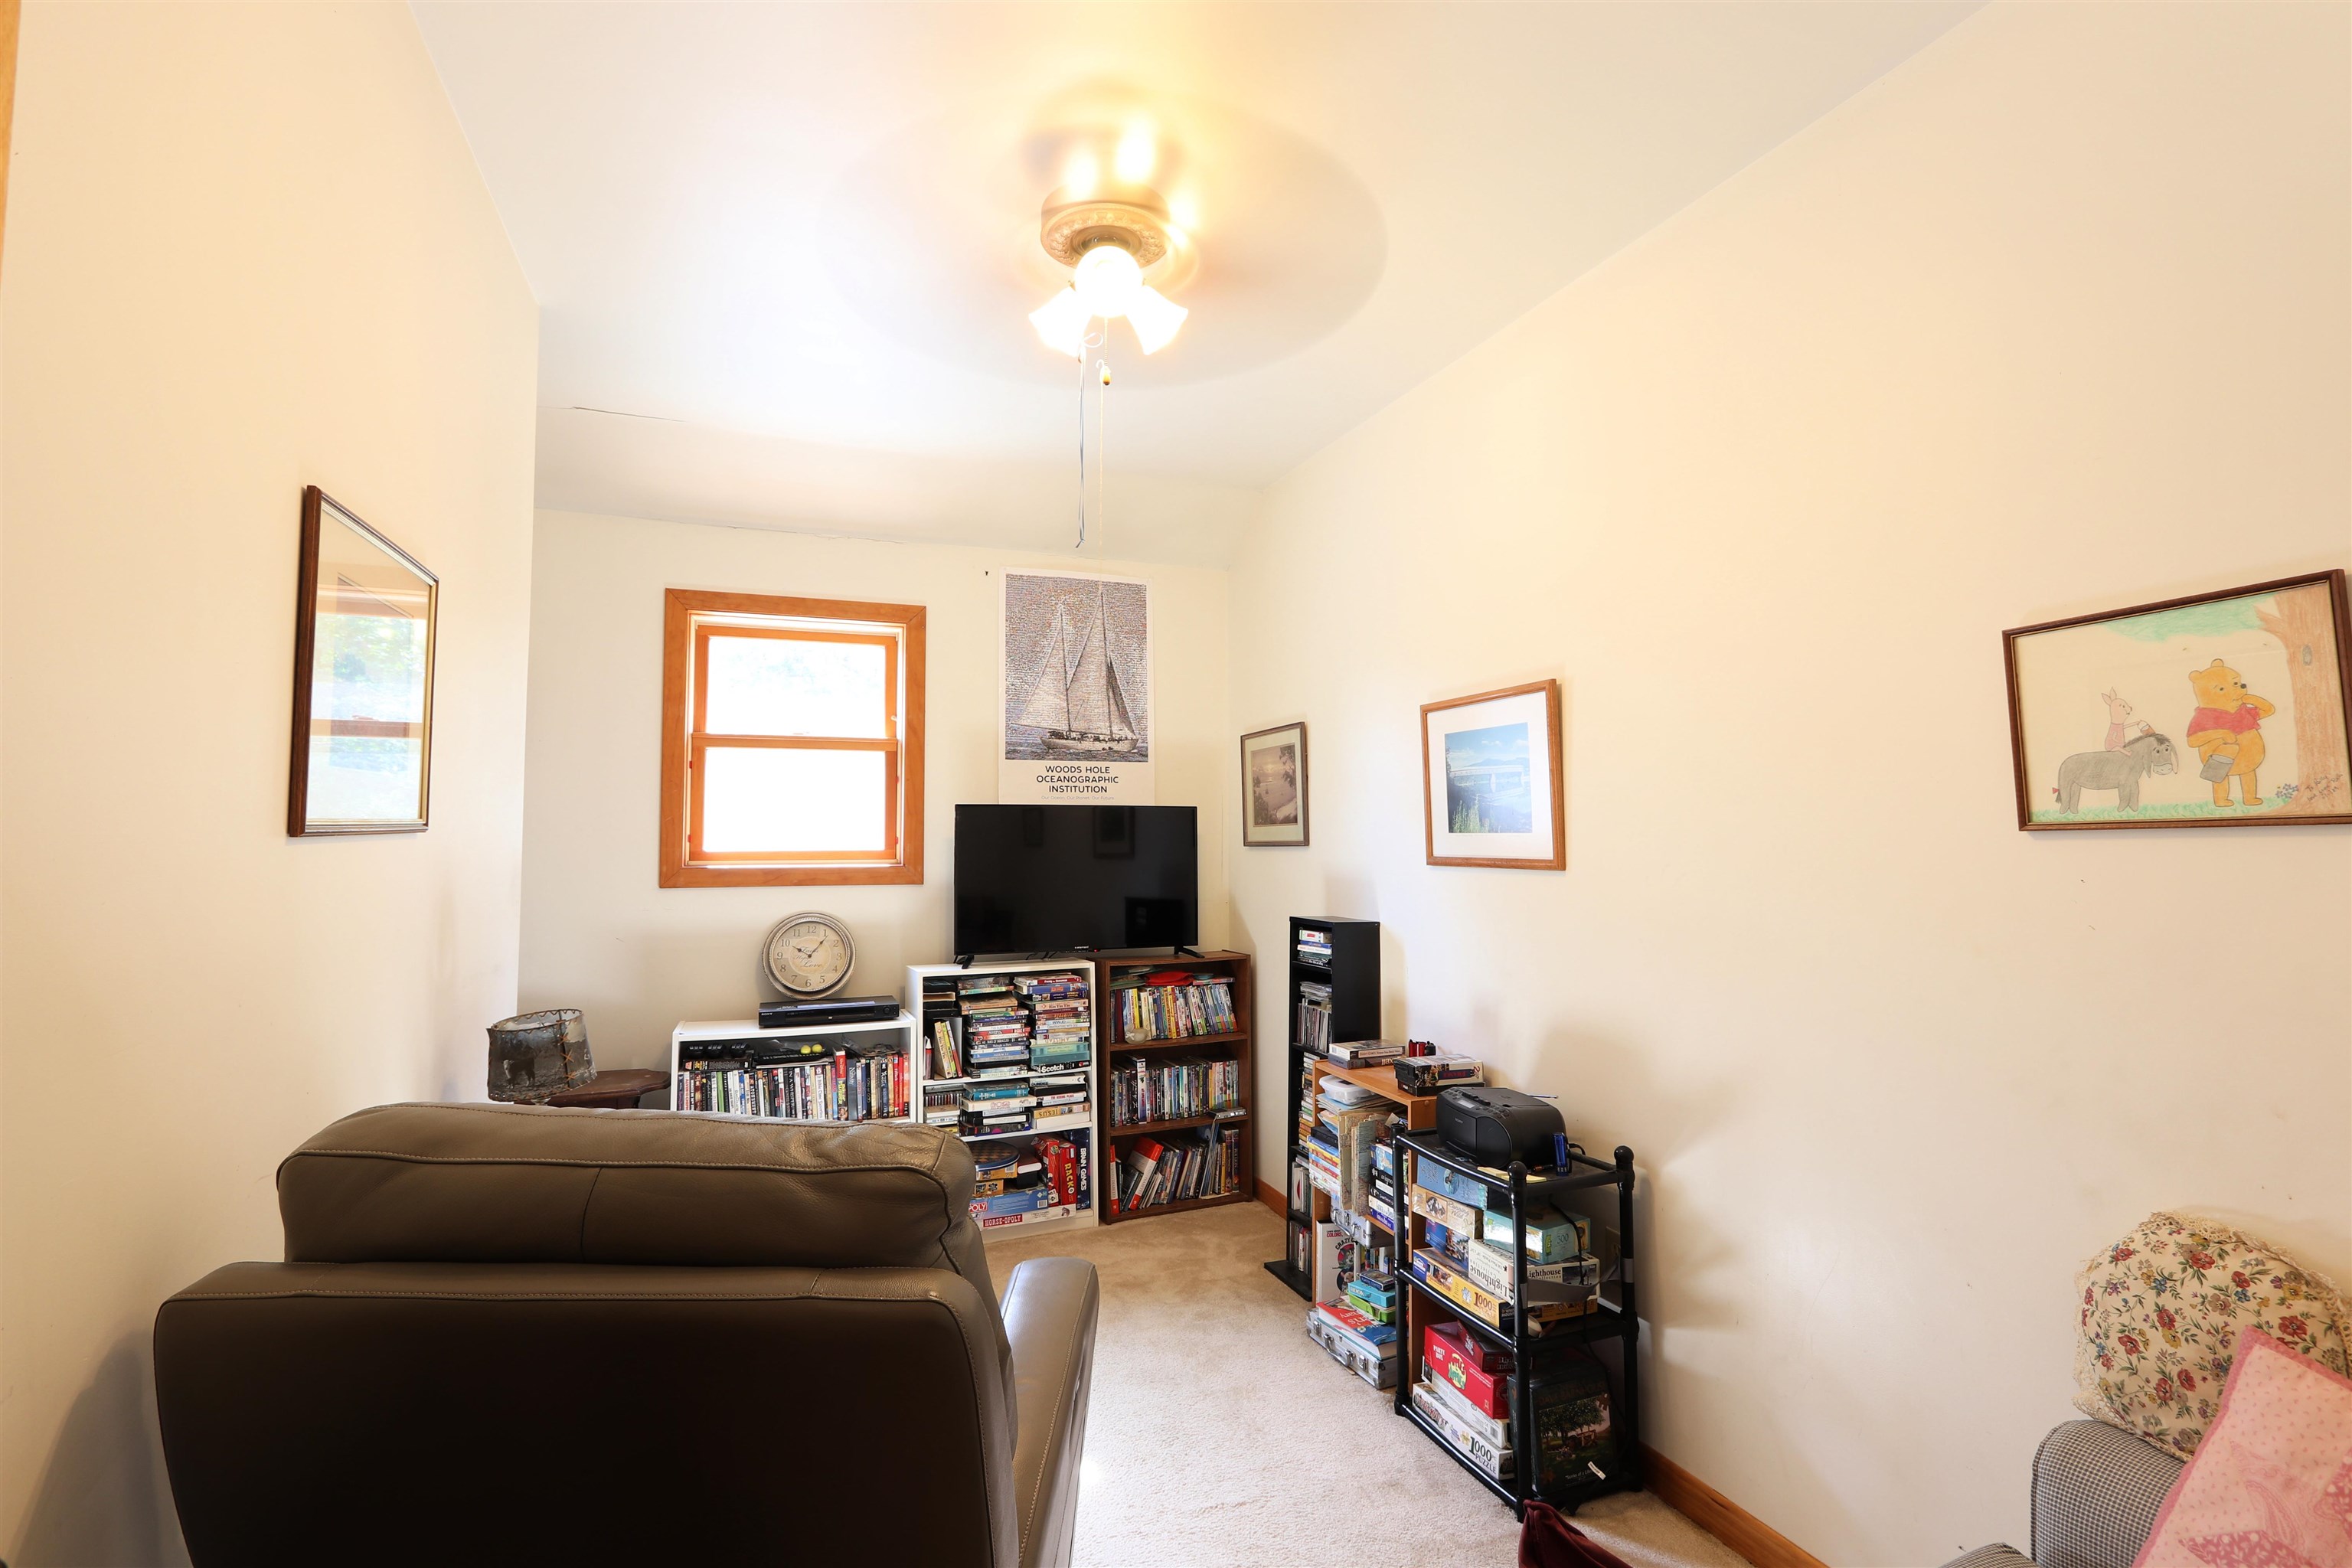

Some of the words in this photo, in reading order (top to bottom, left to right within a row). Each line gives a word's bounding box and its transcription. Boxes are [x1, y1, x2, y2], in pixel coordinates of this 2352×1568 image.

[1036, 775, 1119, 783] OCEANOGRAPHIC
[1049, 785, 1107, 793] INSTITUTION
[807, 925, 816, 933] 12
[781, 939, 790, 947] 10
[836, 952, 842, 961] 3
[1041, 1063, 1064, 1073] Scotch
[1448, 1200, 1469, 1217] Running
[1451, 1210, 1464, 1220] Wild
[985, 1215, 1021, 1227] HORSE-OPOLY
[1334, 1237, 1351, 1250] CRAZY
[1557, 1233, 1570, 1244] 300
[1527, 1268, 1561, 1278] ighthouse
[1470, 1265, 1508, 1297] Lighthouse
[1474, 1292, 1493, 1311] 1000
[1433, 1344, 1446, 1355] PARTY
[1468, 1436, 1492, 1462] 1000
[1475, 1455, 1497, 1475] PUZZLE
